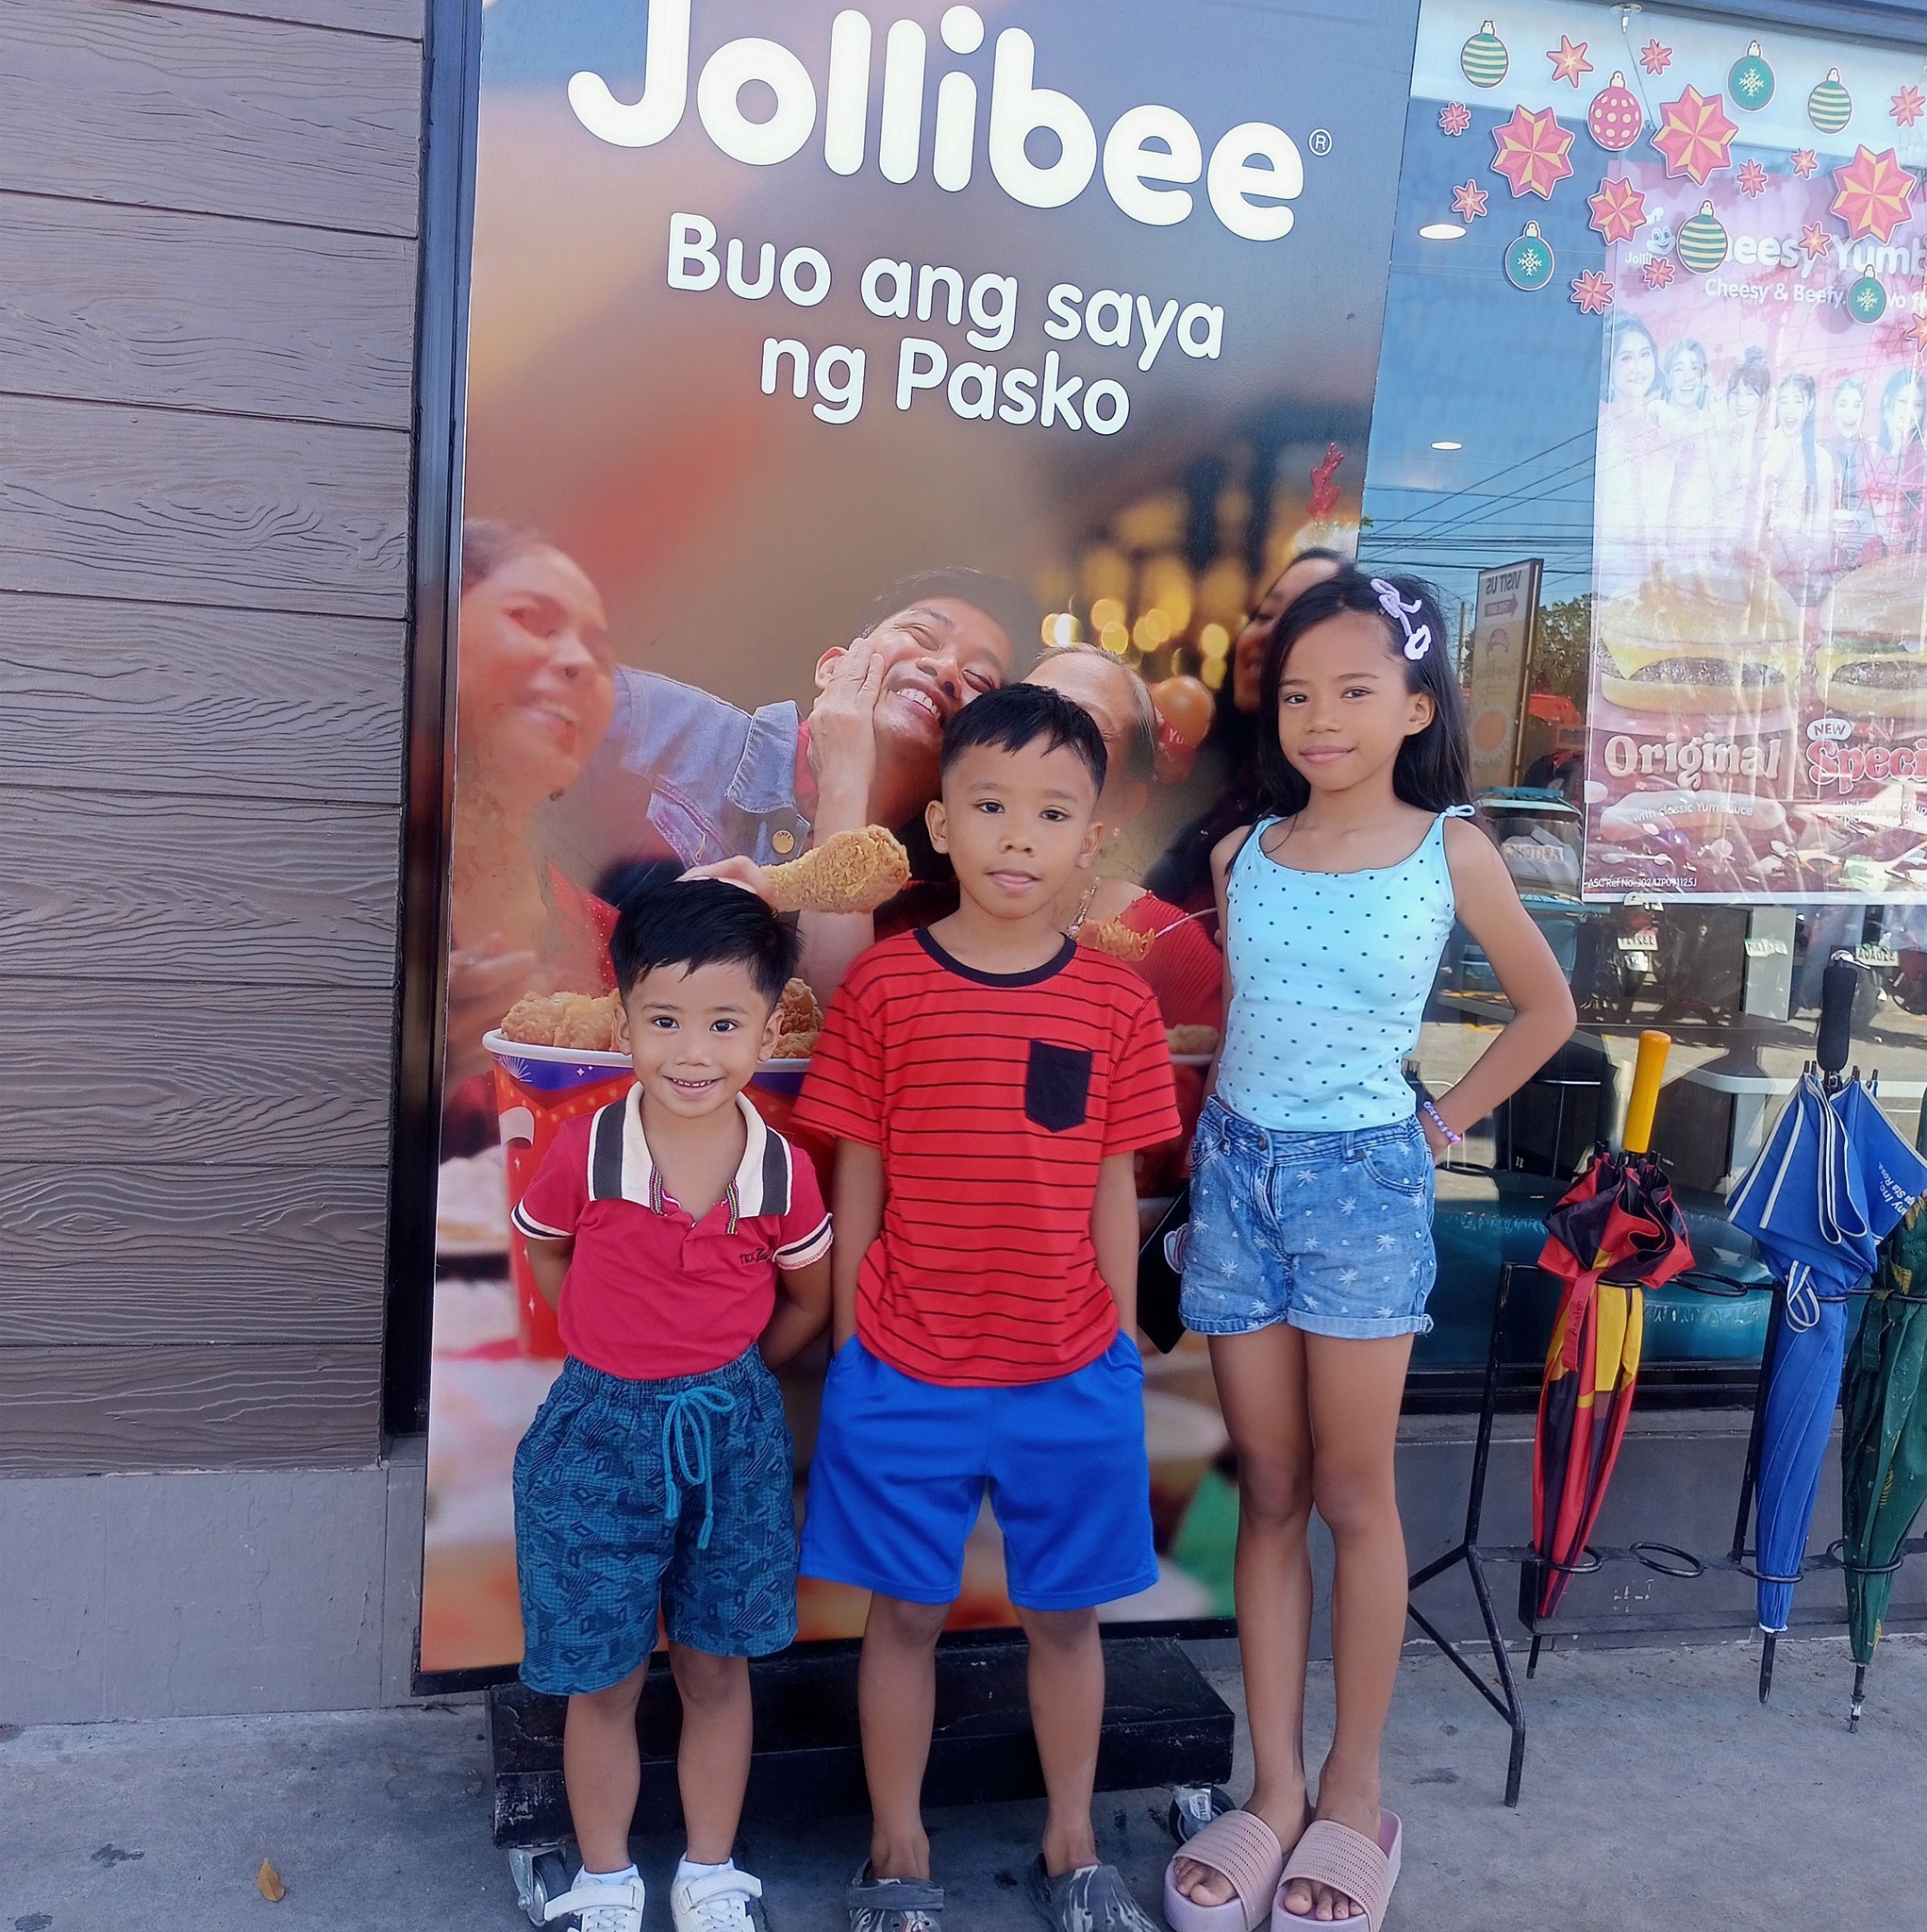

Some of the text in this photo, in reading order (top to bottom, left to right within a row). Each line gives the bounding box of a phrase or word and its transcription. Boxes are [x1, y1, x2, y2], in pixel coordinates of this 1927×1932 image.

[567, 0, 1304, 242] Jollibee
[1624, 251, 1652, 265] Jolli
[1723, 235, 1818, 279] eesy
[667, 212, 1224, 372] Buo ang saya
[1704, 277, 1769, 304] Cheesy
[1773, 282, 1788, 302] &
[1793, 284, 1847, 309] Beefy.
[761, 338, 1129, 435] ng Pasko
[1814, 723, 1846, 736] NEW
[1603, 732, 1782, 791] Original
[1805, 737, 1927, 795] Speci
[1632, 802, 1753, 823] with classic Yum sauce
[1587, 877, 1604, 888] ASC
[1606, 877, 1620, 888] Ref
[1879, 1181, 1894, 1203] Inc.
[1891, 1184, 1906, 1199] Sta
